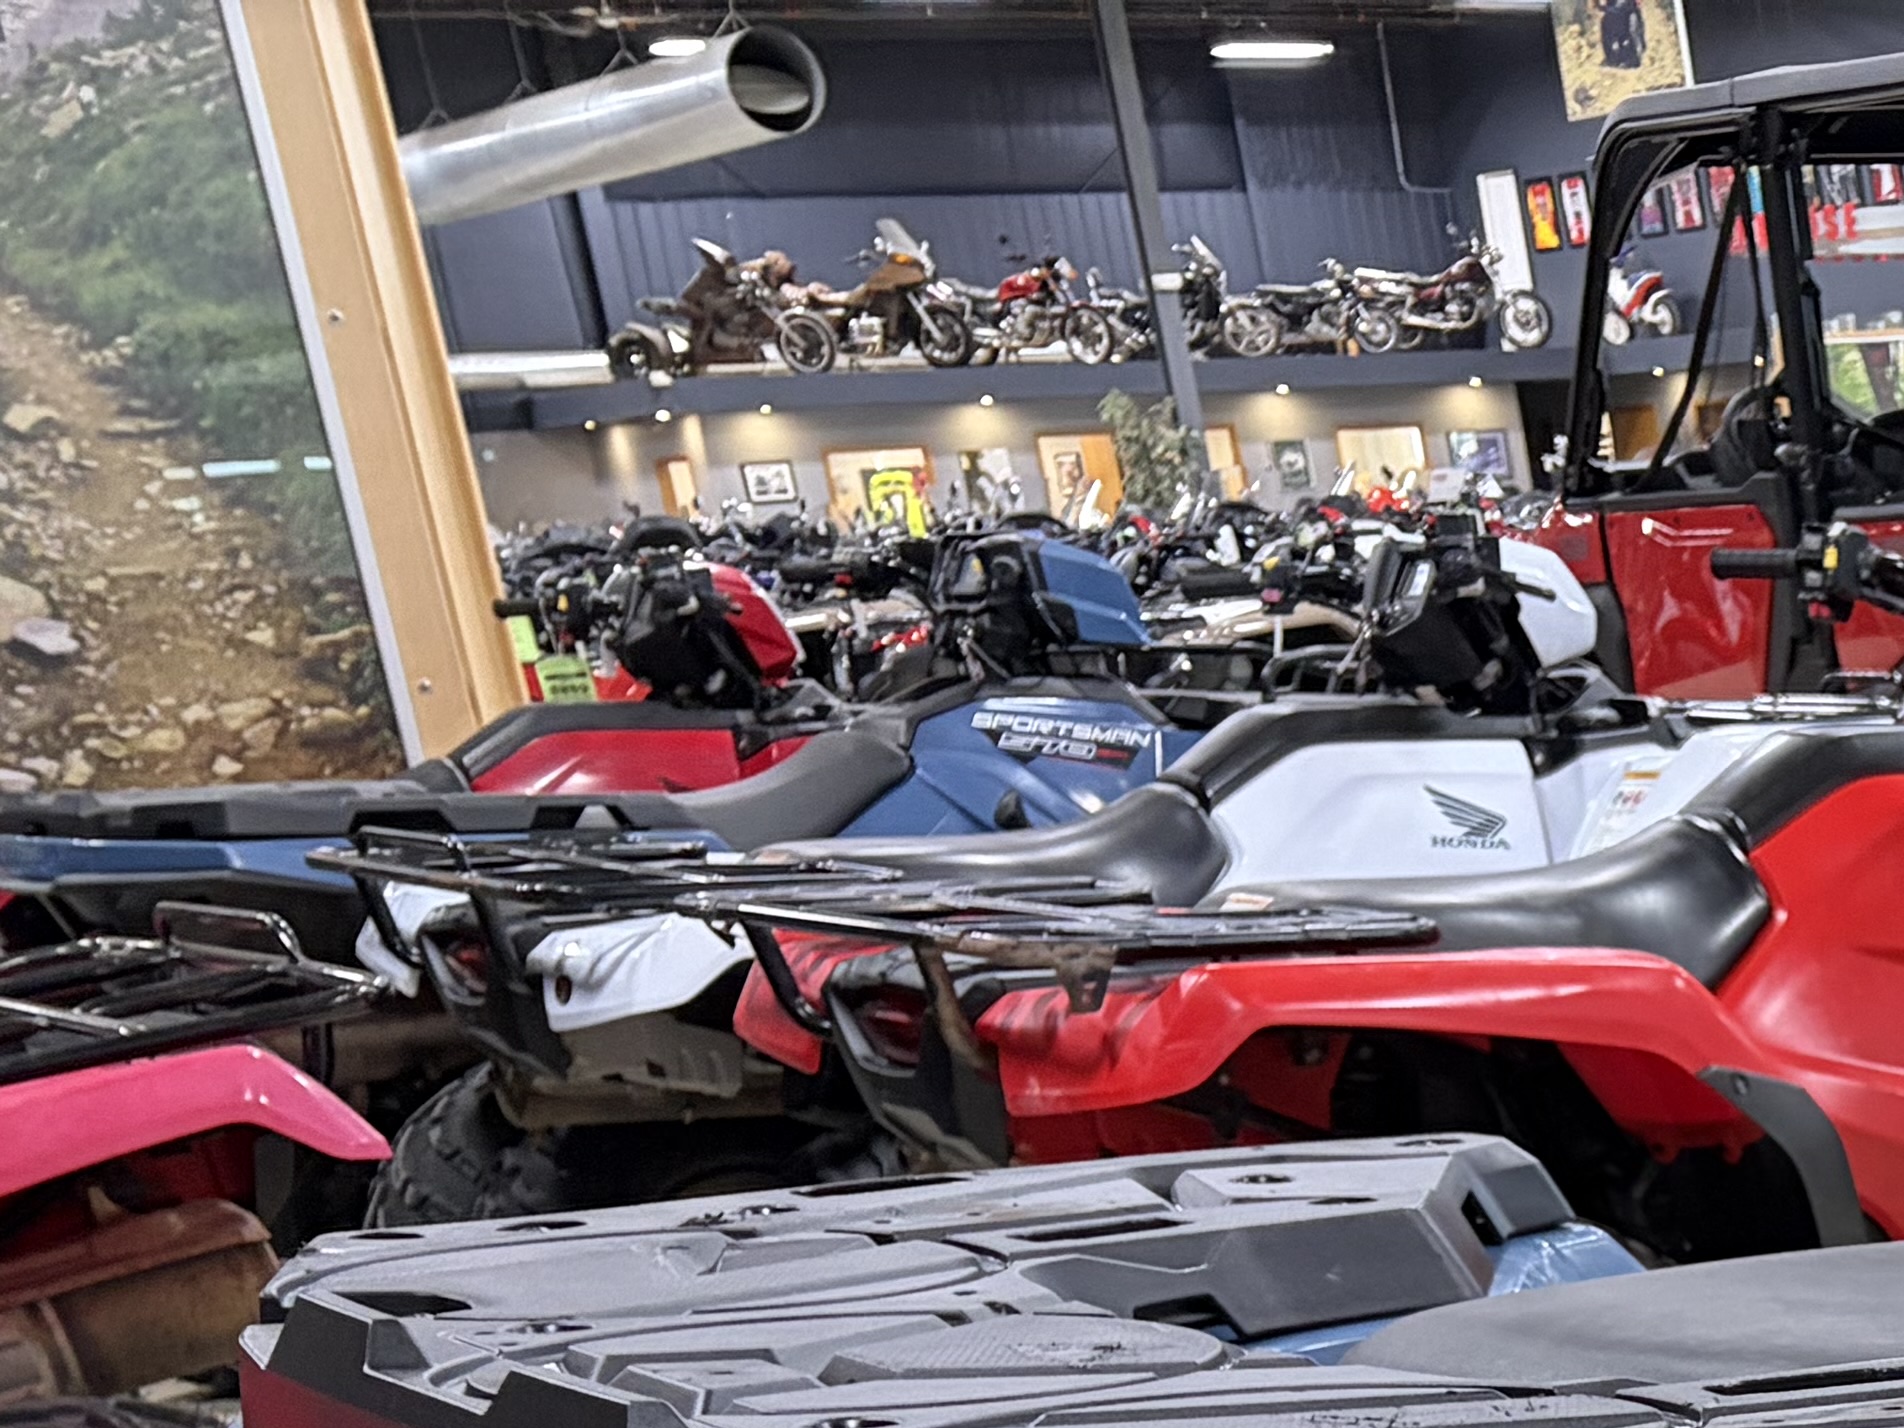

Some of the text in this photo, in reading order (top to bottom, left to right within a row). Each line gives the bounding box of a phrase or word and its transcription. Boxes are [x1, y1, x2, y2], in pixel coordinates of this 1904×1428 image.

[970, 711, 1152, 748] SPORTSMAN
[997, 730, 1098, 761] 570
[1429, 835, 1512, 850] HONDA
